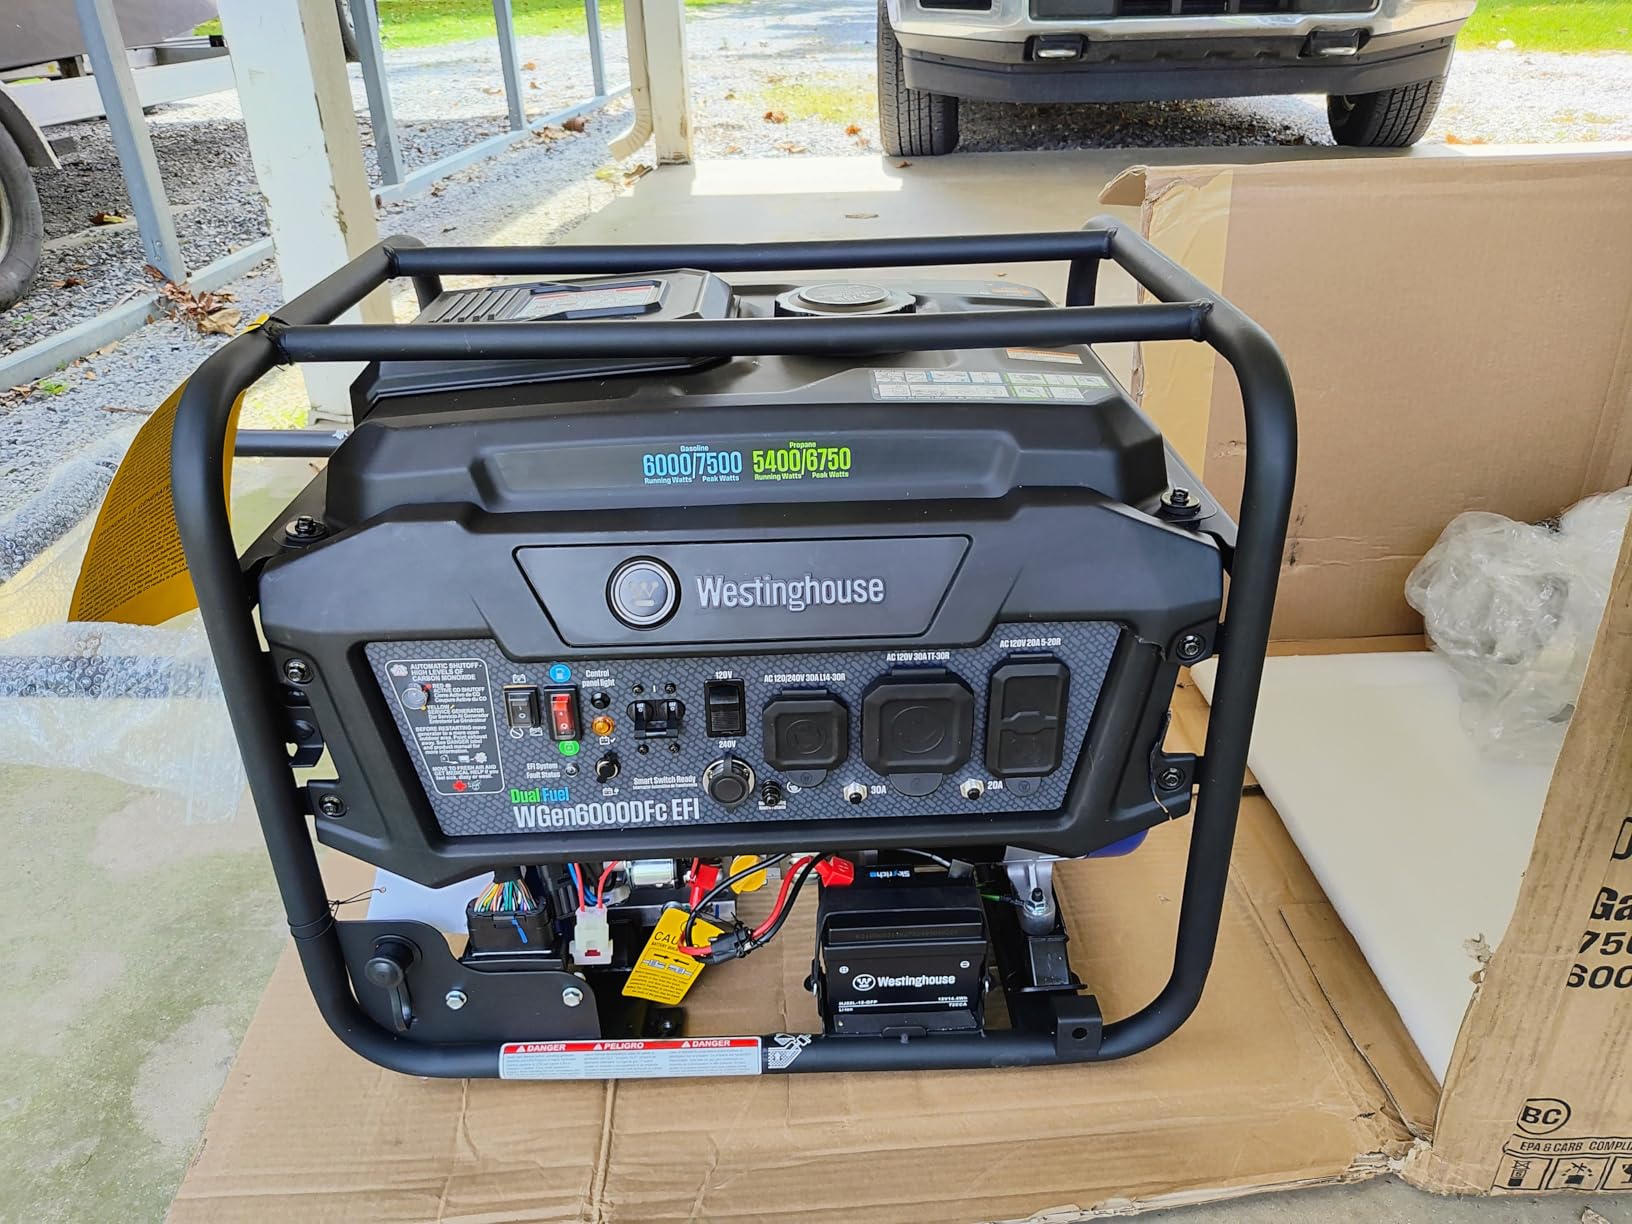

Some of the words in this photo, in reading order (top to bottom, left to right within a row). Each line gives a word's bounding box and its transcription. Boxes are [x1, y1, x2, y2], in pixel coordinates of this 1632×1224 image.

[789, 441, 816, 449] Propane
[643, 451, 742, 478] 6000/7500
[752, 447, 851, 475] 5400/6750
[696, 573, 885, 612] Westinghouse
[1000, 639, 1009, 648] AC
[1010, 639, 1026, 648] 120V
[1027, 638, 1040, 647] 20A
[1041, 638, 1062, 646] 5-20R
[886, 653, 897, 661] AC
[897, 652, 913, 661] 120V
[914, 652, 926, 660] 30A
[586, 669, 609, 678] Control
[764, 674, 774, 683] AC
[774, 674, 805, 683] 120/240V
[806, 673, 819, 682] 30A
[820, 673, 845, 681] L14-30R
[582, 680, 599, 688] panel
[600, 678, 615, 687] light
[536, 762, 558, 771] System
[676, 775, 696, 784] Ready
[871, 785, 886, 794] 30A
[987, 781, 1003, 790] 20A
[510, 788, 540, 804] Dual
[542, 787, 570, 802] Fuel
[513, 800, 667, 828] WGen6000DFc
[672, 798, 700, 821] EFI
[877, 975, 956, 987] Westinghouse
[1521, 1106, 1562, 1124] BC
[1520, 1142, 1540, 1151] EPA
[1553, 1142, 1583, 1152] CARB
